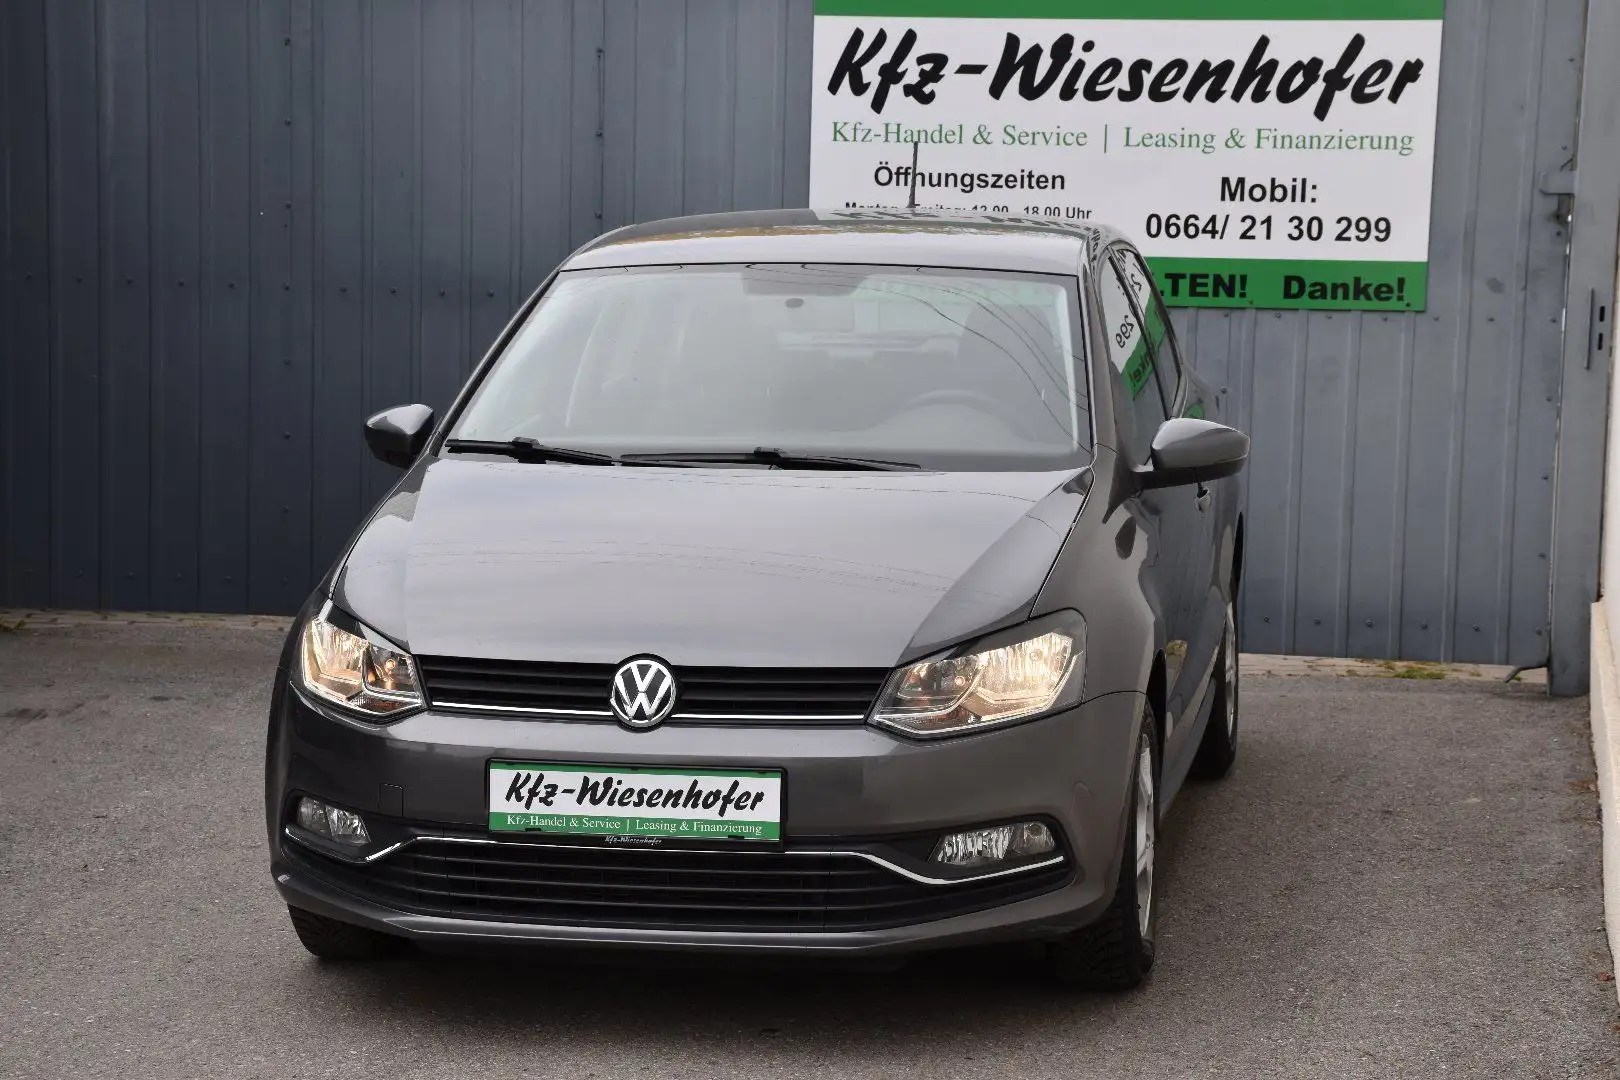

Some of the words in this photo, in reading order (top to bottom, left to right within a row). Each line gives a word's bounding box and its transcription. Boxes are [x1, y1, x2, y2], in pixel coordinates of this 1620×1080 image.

[827, 27, 1424, 122] Kfz-Wiesenhofer
[831, 121, 963, 145] Kfz-Handel
[972, 125, 993, 145] &
[1002, 125, 1088, 147] Service
[1124, 127, 1216, 154] Leasing
[1224, 128, 1247, 149] &
[1255, 128, 1414, 156] Finanzierung
[874, 161, 1066, 193] Öffnungszeiten
[1220, 176, 1318, 203] Mobil:
[1023, 205, 1061, 217] 1800
[1066, 206, 1092, 219] Uhr
[1145, 213, 1230, 240] 0664/
[1239, 214, 1273, 241] 21
[1287, 215, 1324, 242] 30
[1334, 216, 1392, 243] 299
[1159, 272, 1248, 298] TEN!
[1283, 275, 1405, 302] Danke!
[505, 771, 765, 818] Kfz-Wiesenhofer
[507, 814, 566, 827] Kfz-Handel
[569, 817, 578, 827] &
[582, 817, 621, 829] Service
[635, 819, 677, 834] Leasing
[680, 821, 690, 831] &
[693, 822, 763, 835] Finanzierung
